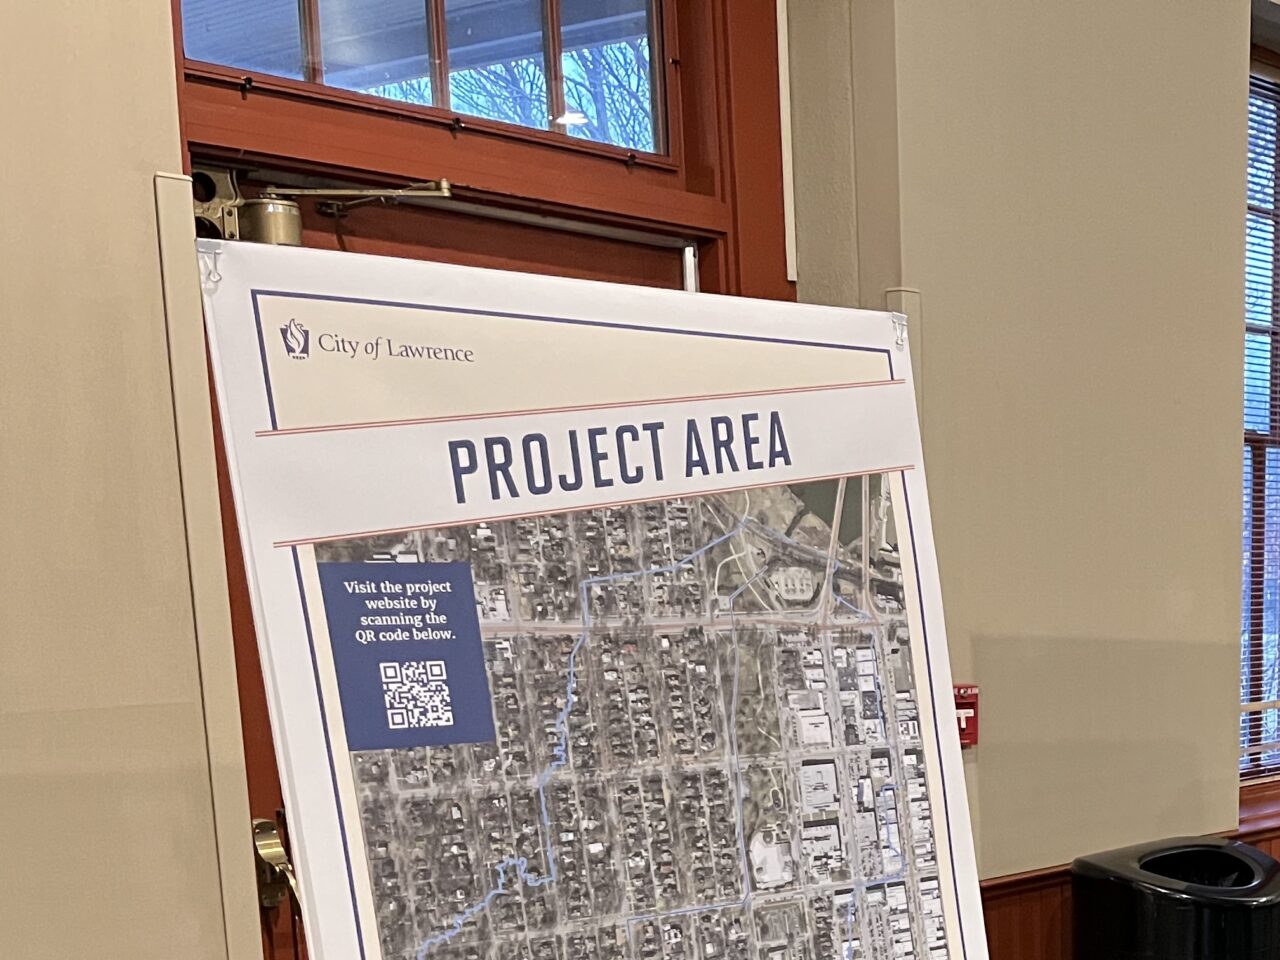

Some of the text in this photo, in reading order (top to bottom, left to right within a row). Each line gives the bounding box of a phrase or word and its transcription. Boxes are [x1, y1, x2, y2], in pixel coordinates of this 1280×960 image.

[318, 333, 475, 362] City of Lawrence
[448, 411, 792, 504] PROJECT AREA
[344, 580, 452, 595] Visit the project
[365, 596, 437, 611] website by
[360, 612, 447, 627] scanning the
[355, 627, 456, 644] QR code below.
